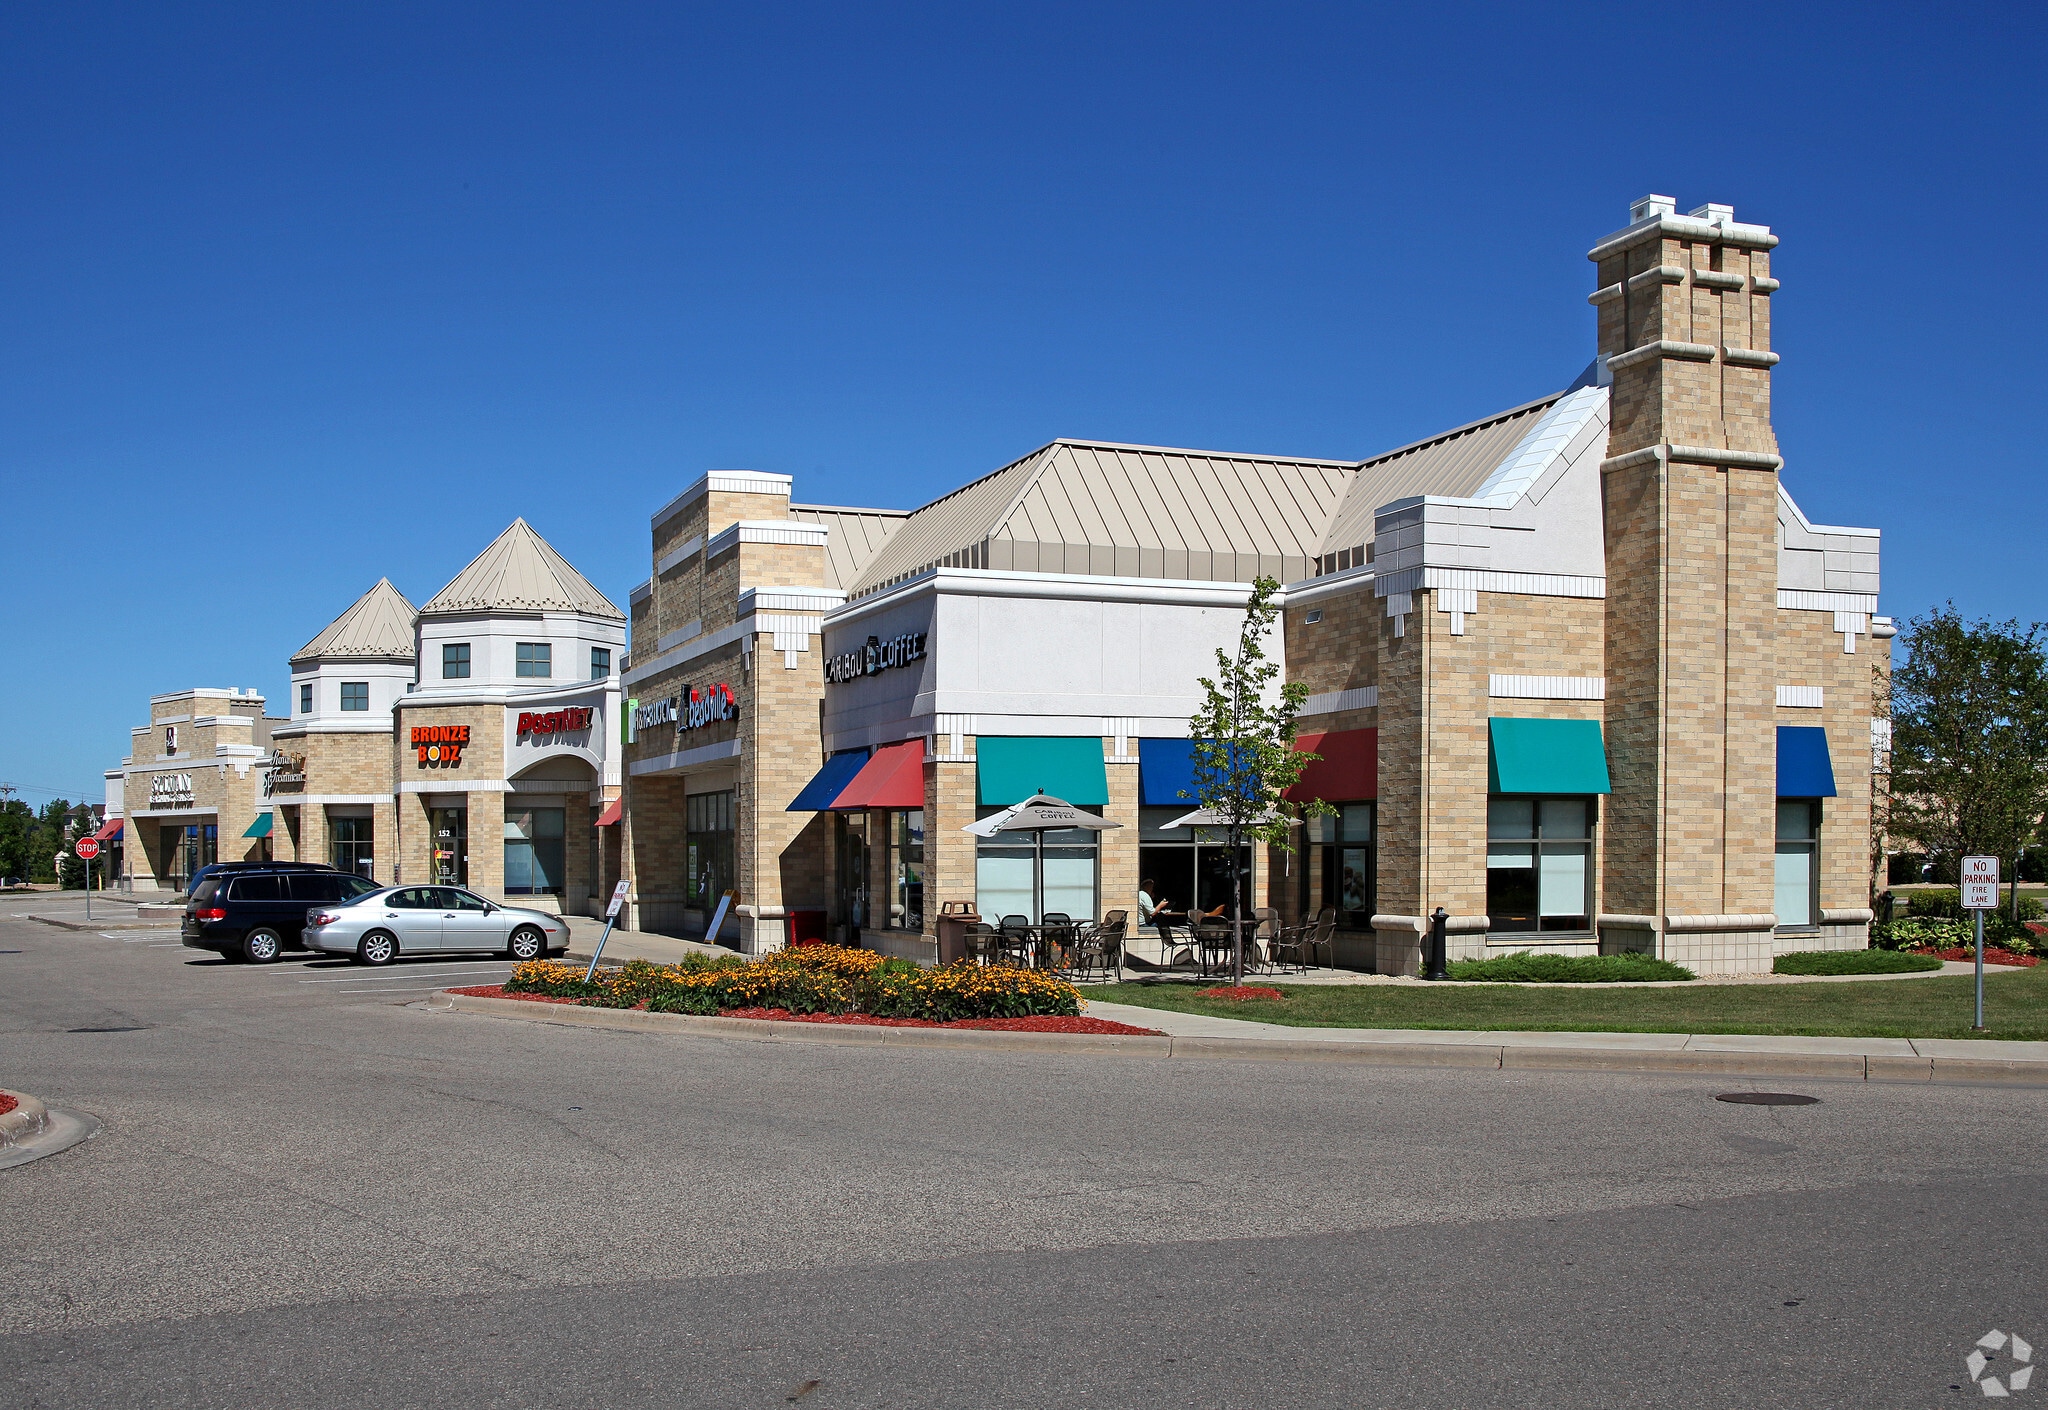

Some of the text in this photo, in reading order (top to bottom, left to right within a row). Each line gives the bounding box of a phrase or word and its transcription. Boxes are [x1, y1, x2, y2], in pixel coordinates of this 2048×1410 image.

[824, 633, 920, 683] CARIBOU COFFEE
[648, 698, 672, 727] BLOCK
[517, 708, 589, 736] POSTNET
[411, 725, 468, 743] BRONZE
[418, 745, 460, 762] BODZ
[78, 844, 97, 852] STOP
[1973, 862, 1987, 872] NO
[1964, 874, 1996, 884] PARKING
